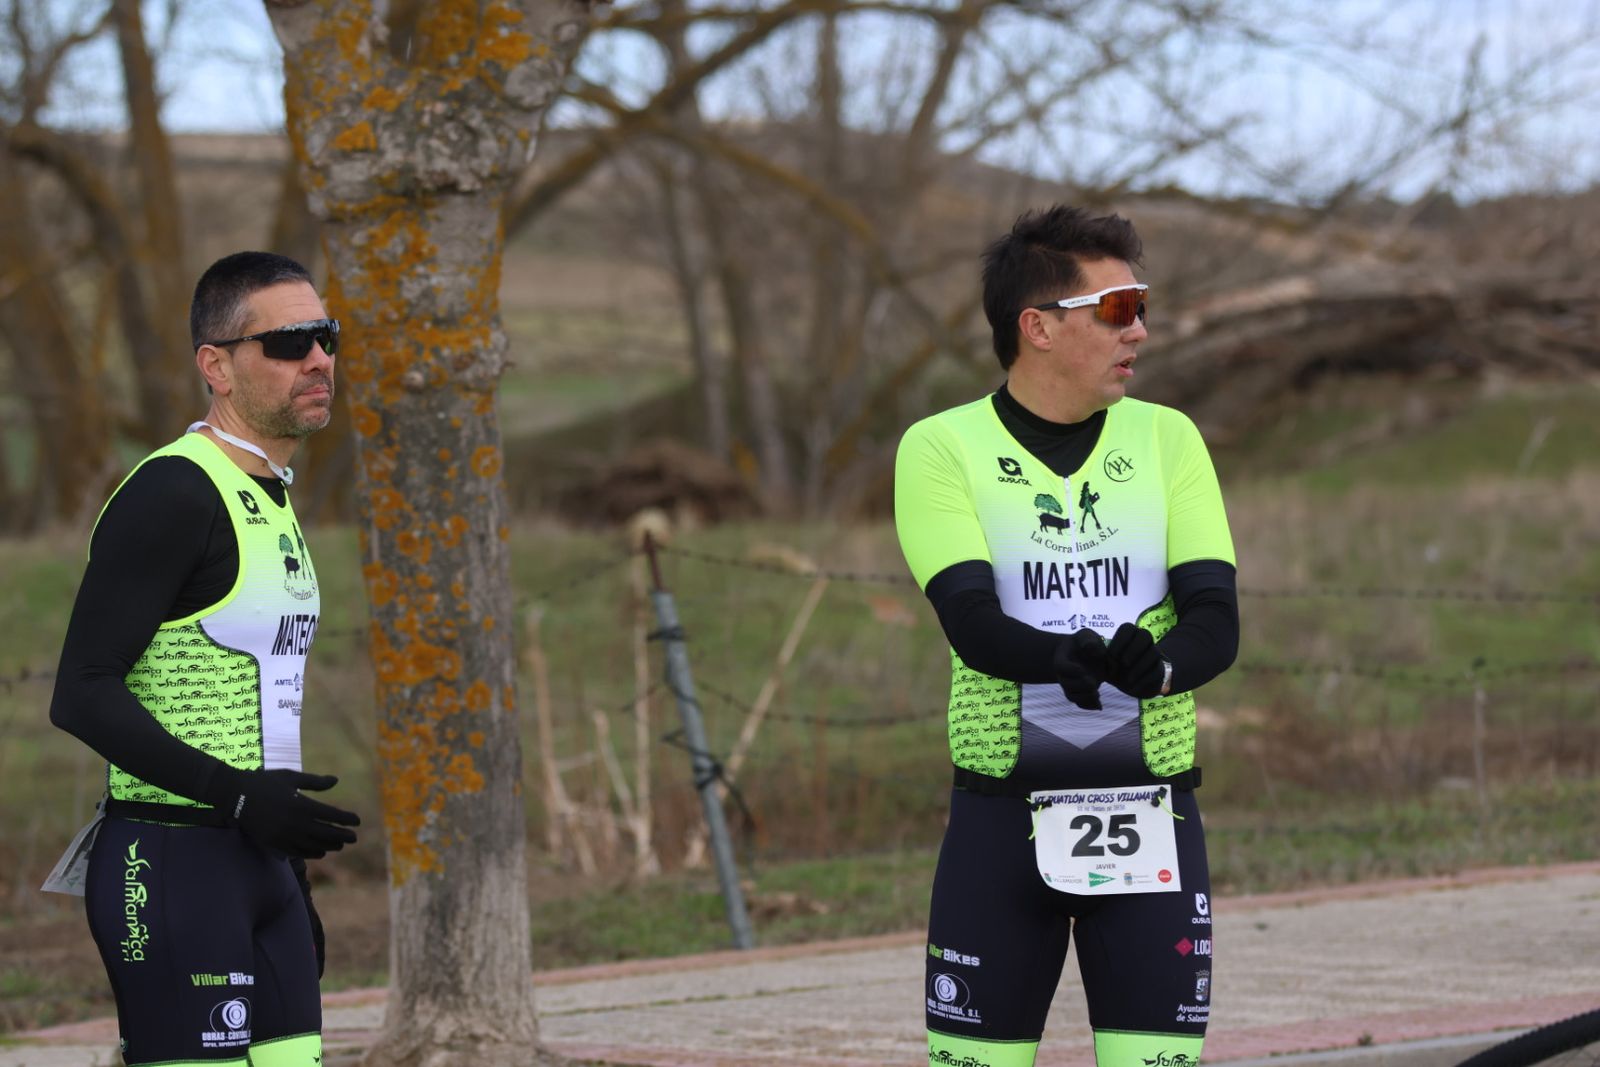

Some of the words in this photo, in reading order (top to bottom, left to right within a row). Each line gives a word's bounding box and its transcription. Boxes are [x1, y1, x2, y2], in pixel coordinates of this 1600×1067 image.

[1030, 530, 1043, 545] La
[1023, 556, 1129, 600] MARTIN
[1087, 793, 1115, 803] CROSS
[1117, 790, 1160, 802] VILLAMAY
[1070, 814, 1141, 857] 25
[1176, 1013, 1186, 1022] de
